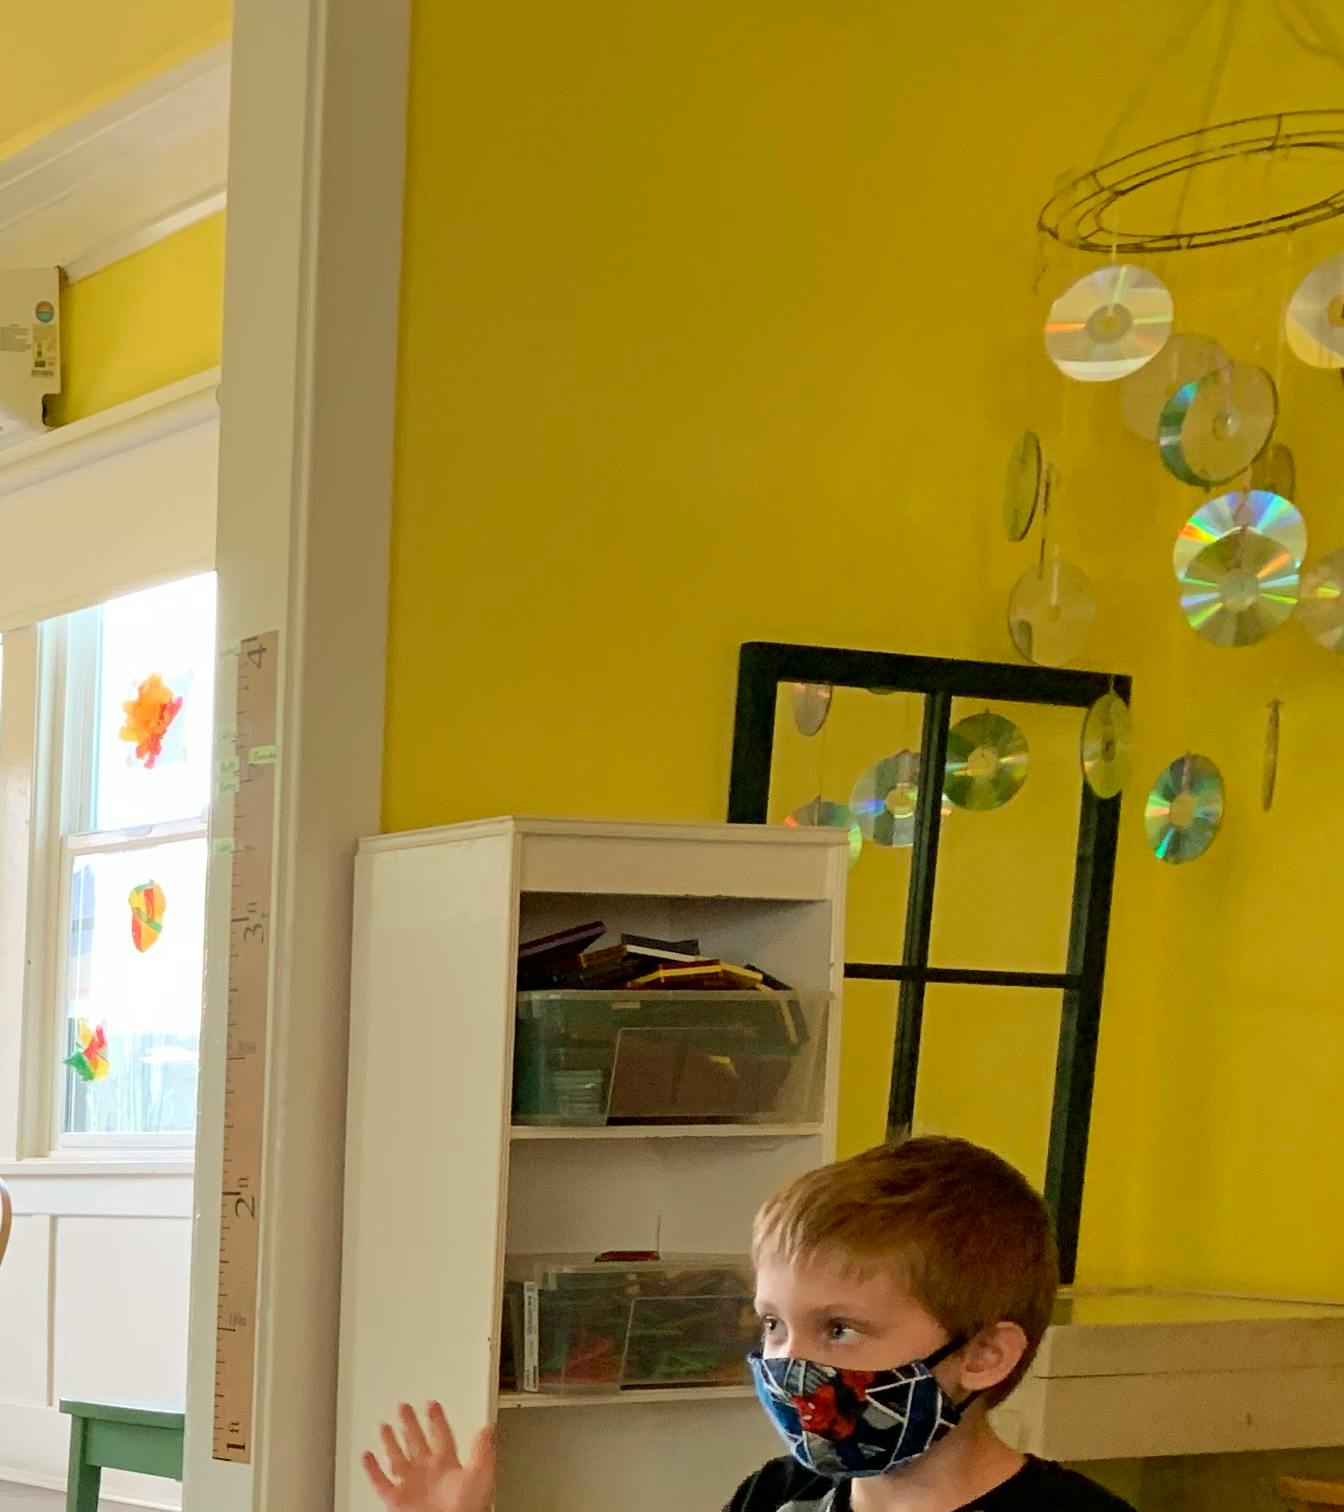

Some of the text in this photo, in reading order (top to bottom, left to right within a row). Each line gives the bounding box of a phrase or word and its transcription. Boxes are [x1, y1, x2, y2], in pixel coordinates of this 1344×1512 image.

[247, 643, 267, 669] 4
[243, 923, 264, 944] 3
[235, 1196, 256, 1219] 2
